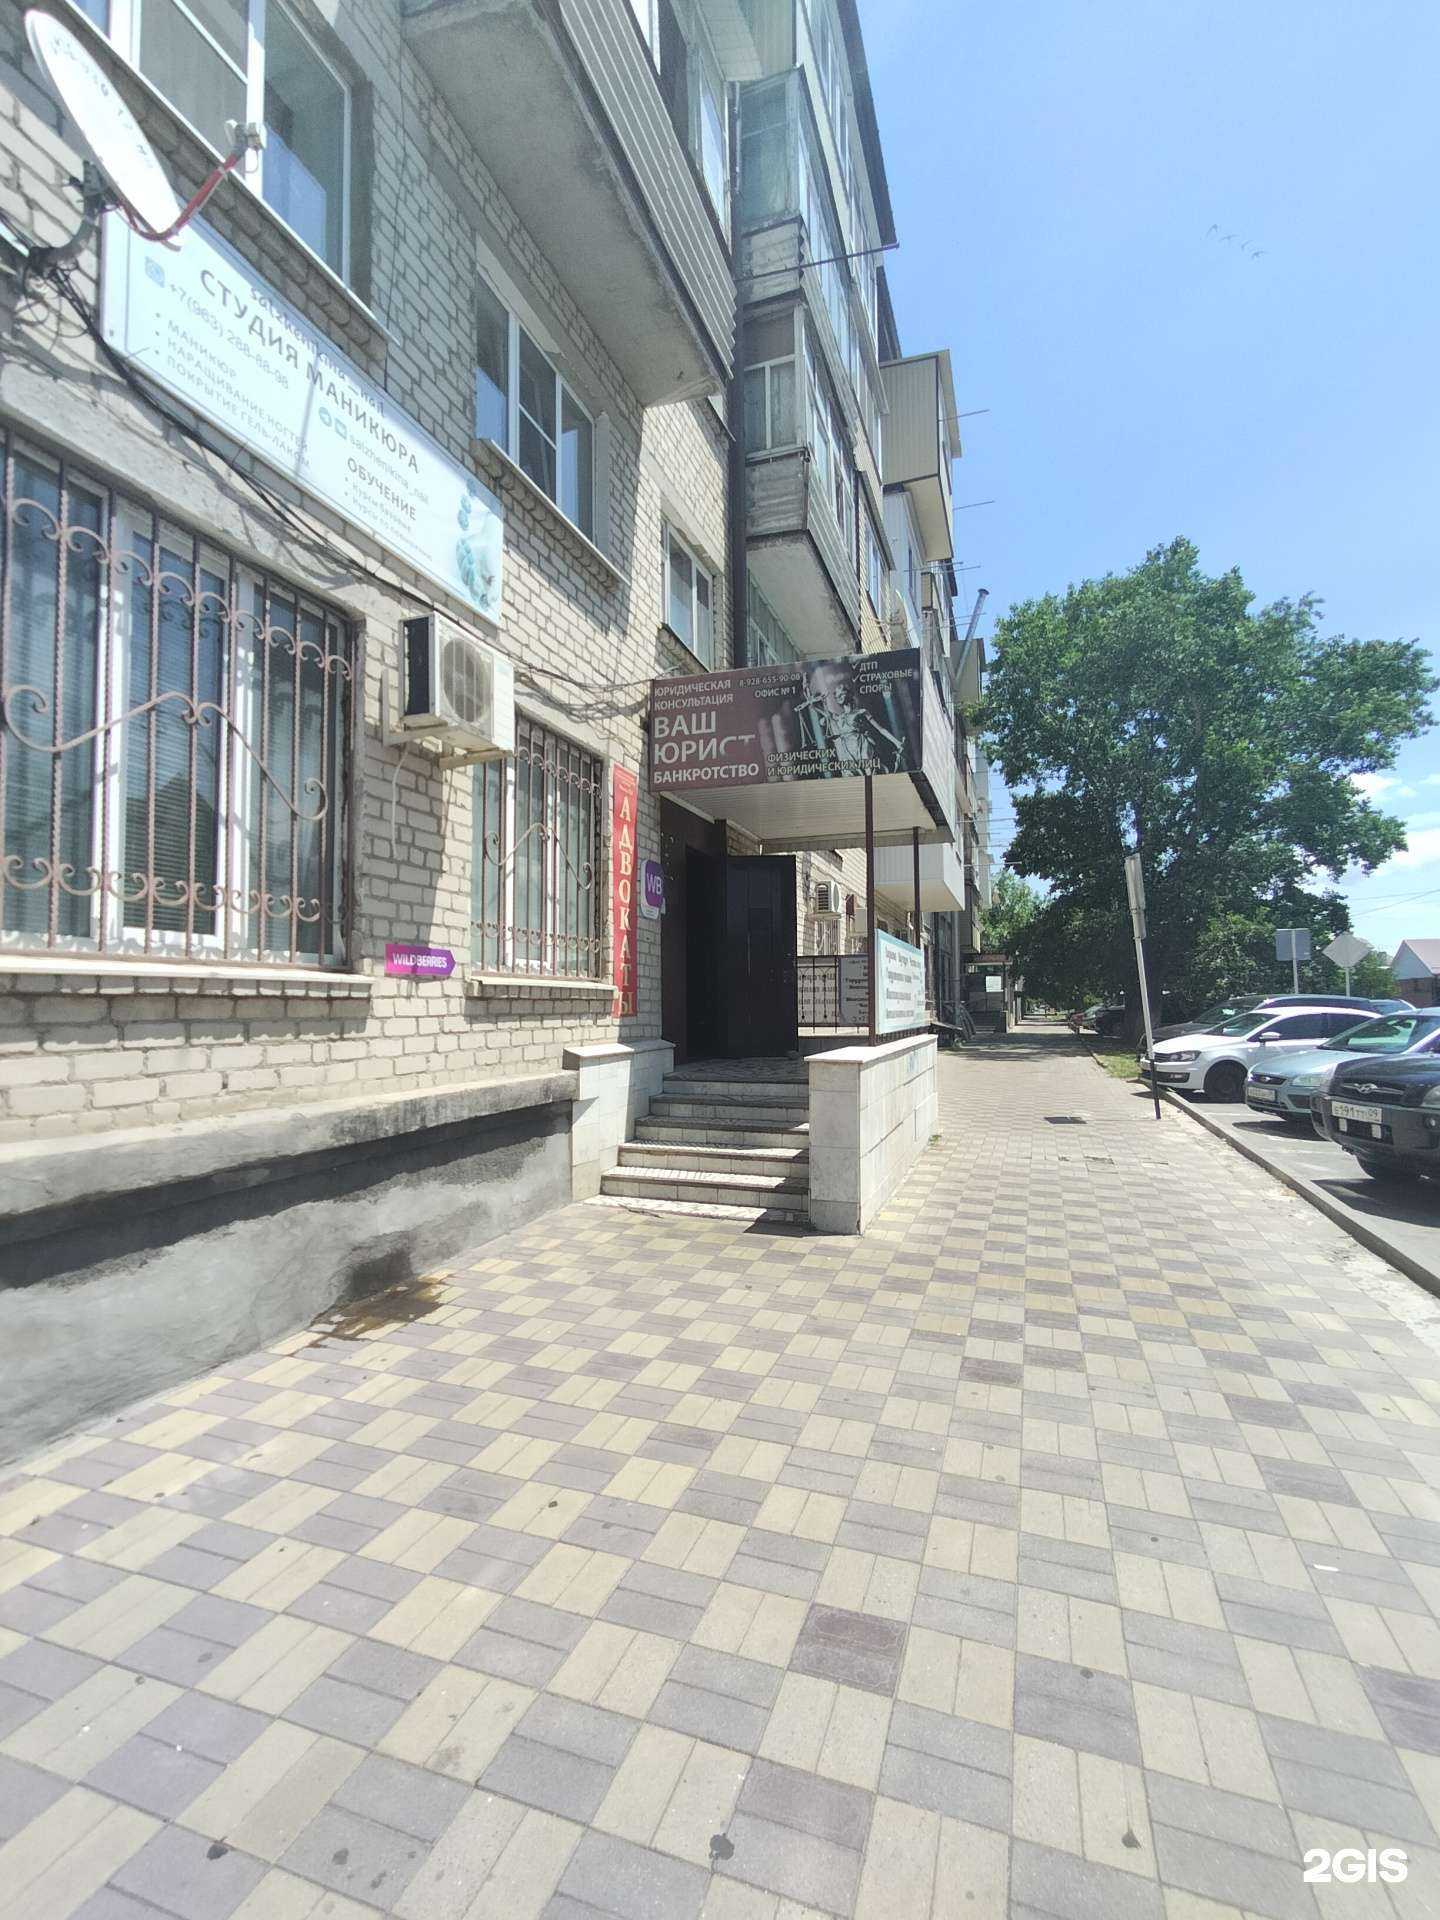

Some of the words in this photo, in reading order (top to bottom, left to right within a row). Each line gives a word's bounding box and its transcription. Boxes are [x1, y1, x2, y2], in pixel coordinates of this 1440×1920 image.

[168, 319, 236, 379] МАНИКЮР
[167, 338, 264, 420] НАРАЩИВАНИЕ
[200, 269, 298, 370] СТУДИЯ
[306, 363, 419, 474] МАНИКЮРА
[167, 356, 237, 417] ПОКРЫТИЕ
[347, 456, 416, 521] ОБУЧЕНИЕ
[859, 661, 878, 672] ДТП
[859, 668, 913, 682] СТРАХОВЫЕ
[654, 680, 731, 697] ЮРИДИЧЕСКАЯ
[754, 688, 780, 698] ОФИС
[791, 686, 797, 694] 1
[859, 682, 892, 694] СПОРЫ
[654, 693, 734, 711] КОНСУЛЬТАЦИЯ
[654, 711, 716, 738] ВАШ
[767, 748, 836, 763] ФИЗИЧЕСКИХ
[653, 763, 759, 784] БАНКРОТСТВО
[767, 767, 775, 776] И
[777, 761, 856, 776] ЮРИДИЧЕСКИХ
[857, 757, 880, 770] ЛИЦ
[646, 872, 662, 895] WB
[617, 796, 634, 1015] АДВОКАТЫ
[392, 952, 448, 968] WILDBERRIES
